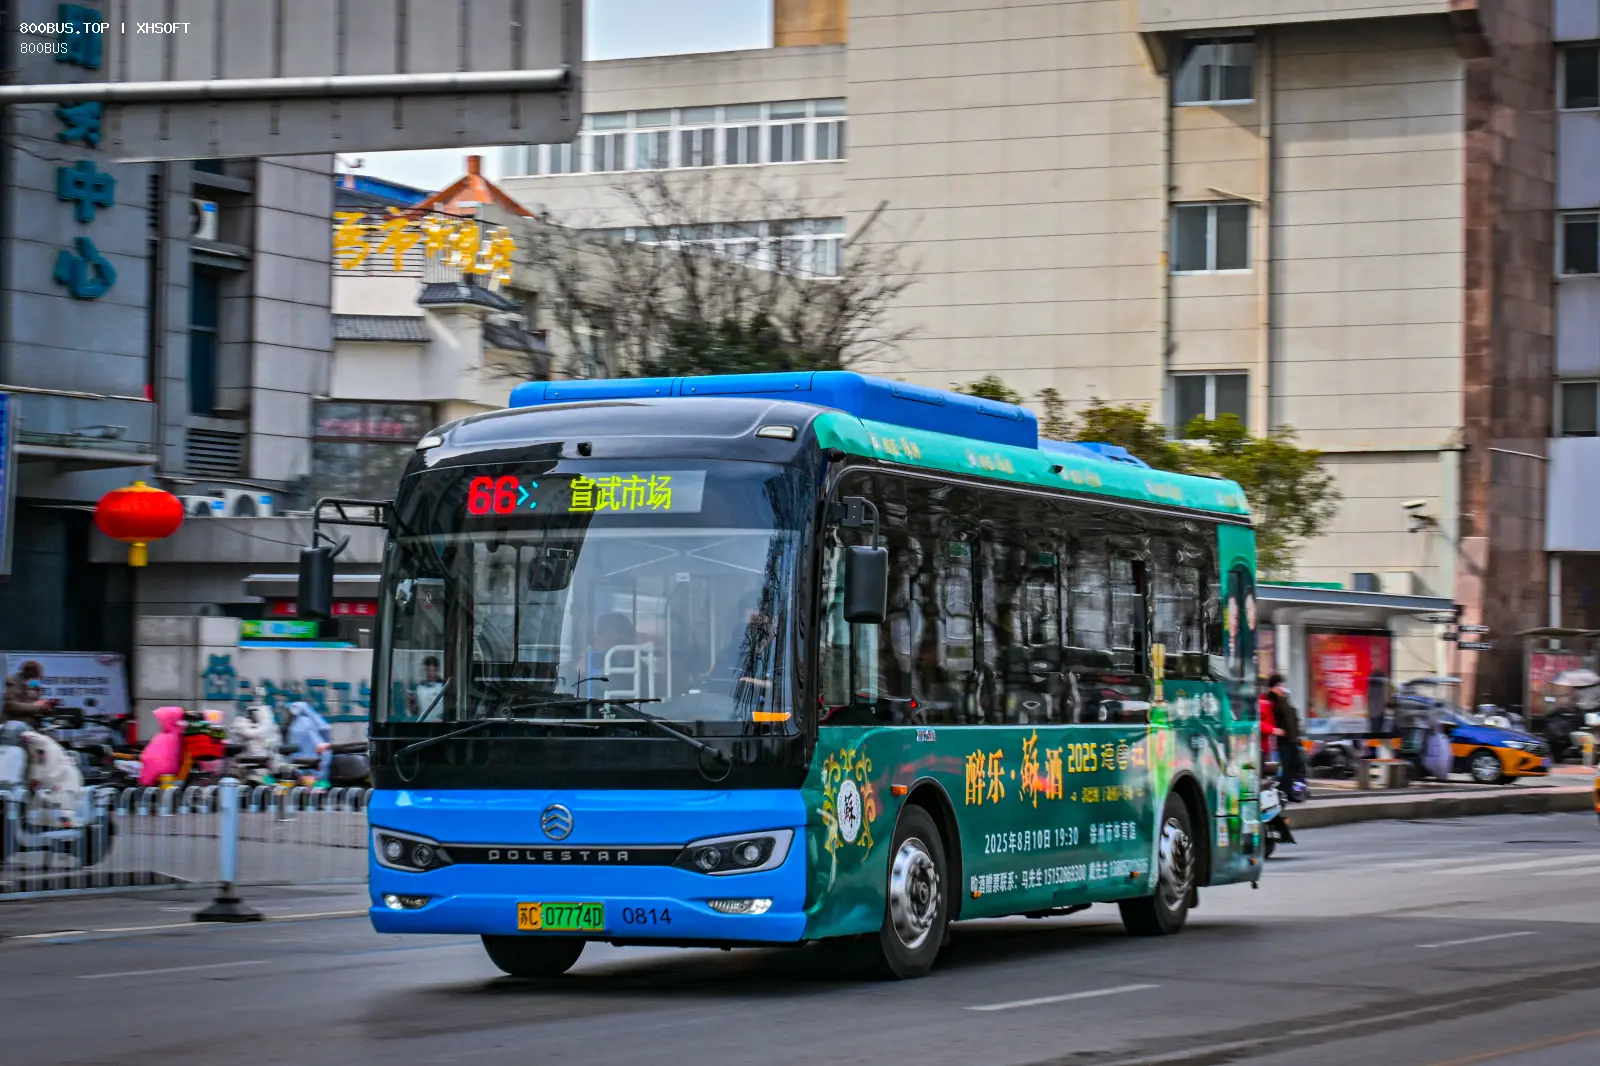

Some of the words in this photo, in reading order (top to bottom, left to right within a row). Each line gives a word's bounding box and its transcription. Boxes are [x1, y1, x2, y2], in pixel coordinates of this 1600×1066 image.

[467, 475, 519, 515] 66
[568, 474, 672, 512] 宣武市场
[1067, 742, 1098, 773] 2025
[984, 829, 1051, 854] 2025年8月10日
[1054, 826, 1079, 847] 19:30
[488, 849, 629, 861] POLESTAR
[1021, 868, 1043, 889] 马先生
[622, 906, 672, 925] 0814
